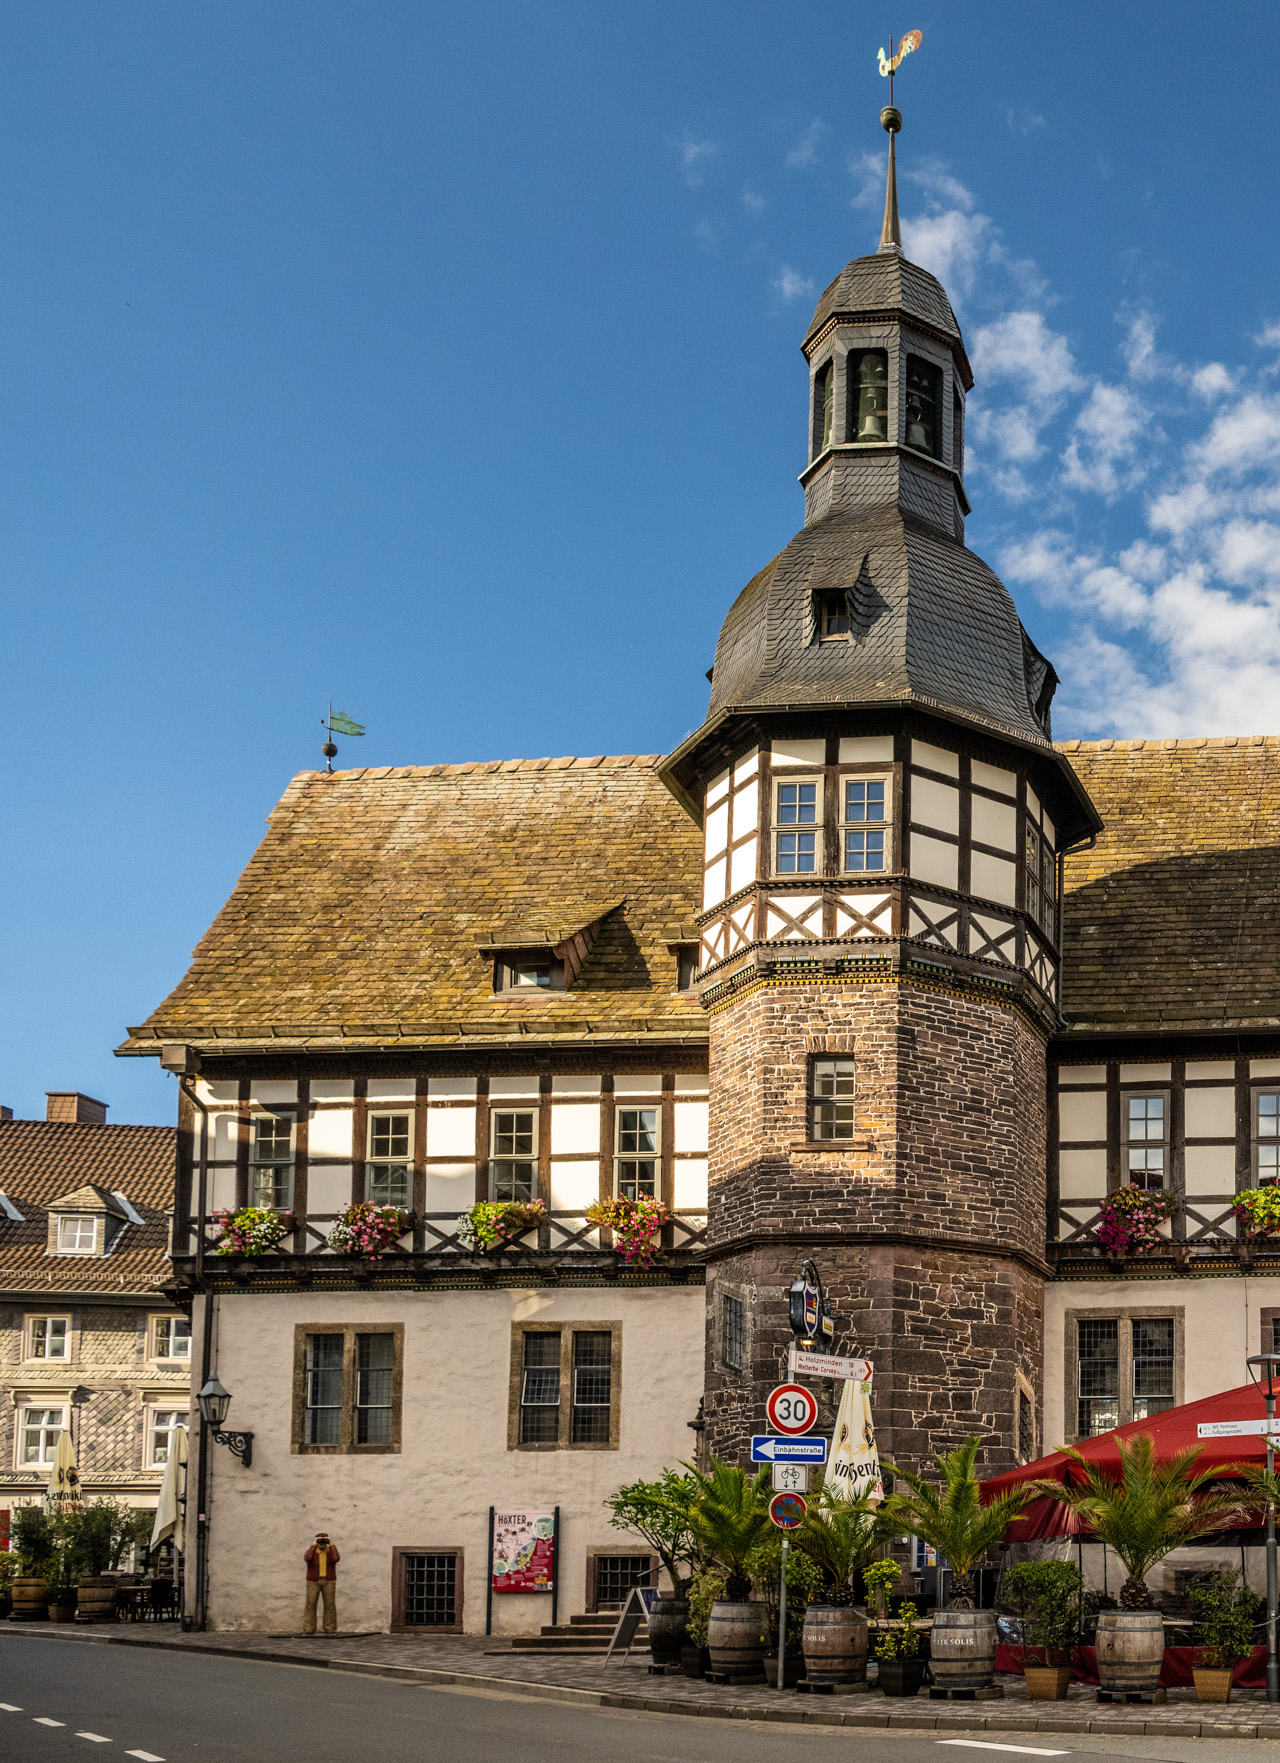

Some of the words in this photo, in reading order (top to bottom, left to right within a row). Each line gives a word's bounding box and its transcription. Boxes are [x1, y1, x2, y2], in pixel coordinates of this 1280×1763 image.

[805, 1355, 843, 1367] Holzminden
[797, 1363, 819, 1372] Welterbe
[820, 1366, 837, 1375] Corvey
[779, 1398, 806, 1421] 30
[949, 1638, 974, 1646] SOLIS
